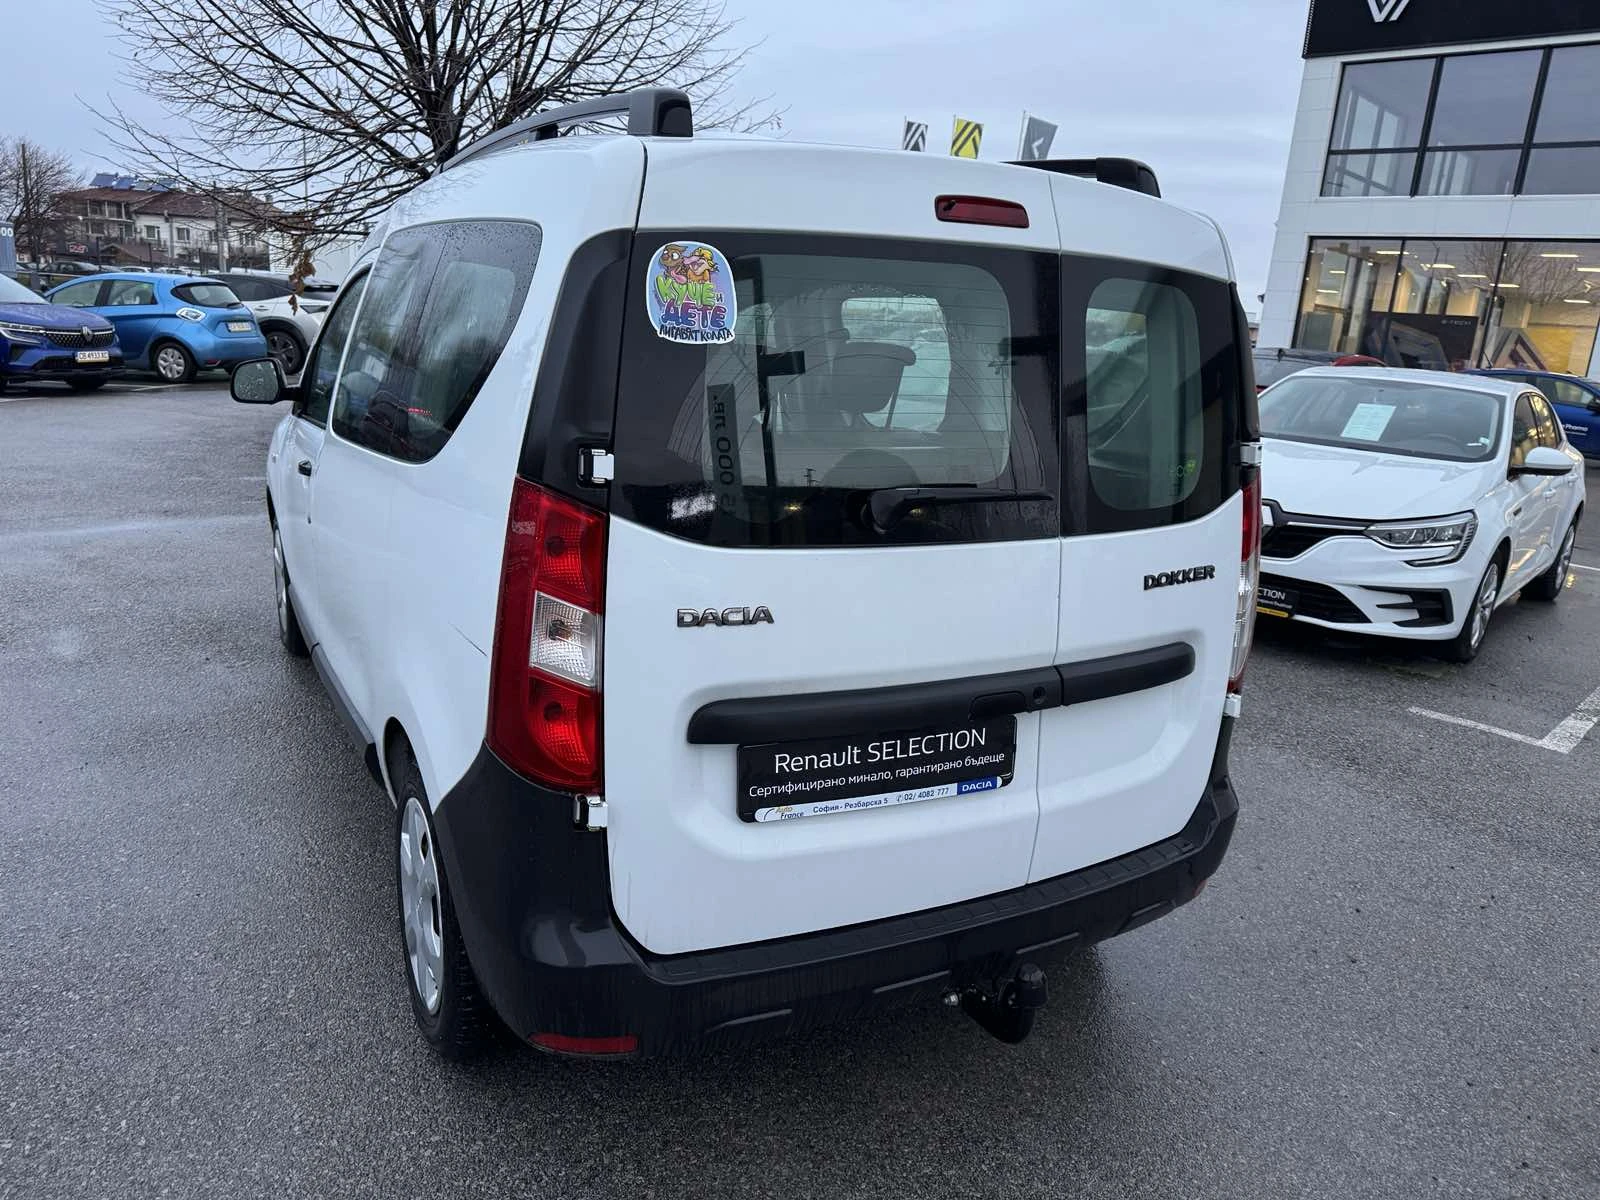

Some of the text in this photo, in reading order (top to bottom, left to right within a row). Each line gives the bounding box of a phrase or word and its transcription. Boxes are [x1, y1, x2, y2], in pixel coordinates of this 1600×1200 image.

[656, 275, 716, 307] КУЧЕ
[661, 299, 727, 329] ДЕТЕ
[700, 327, 733, 342] КОЛАТА
[1143, 564, 1216, 591] DOKKER
[677, 605, 775, 628] DACIA
[774, 727, 986, 774] Renault SELECTION
[749, 752, 1005, 798] Сертифицирано минало, гарантирано бъдеще
[961, 780, 993, 792] DACIA
[937, 787, 949, 796] 777
[780, 811, 804, 820] France
[813, 806, 839, 815] София
[844, 799, 881, 810] Резбарска
